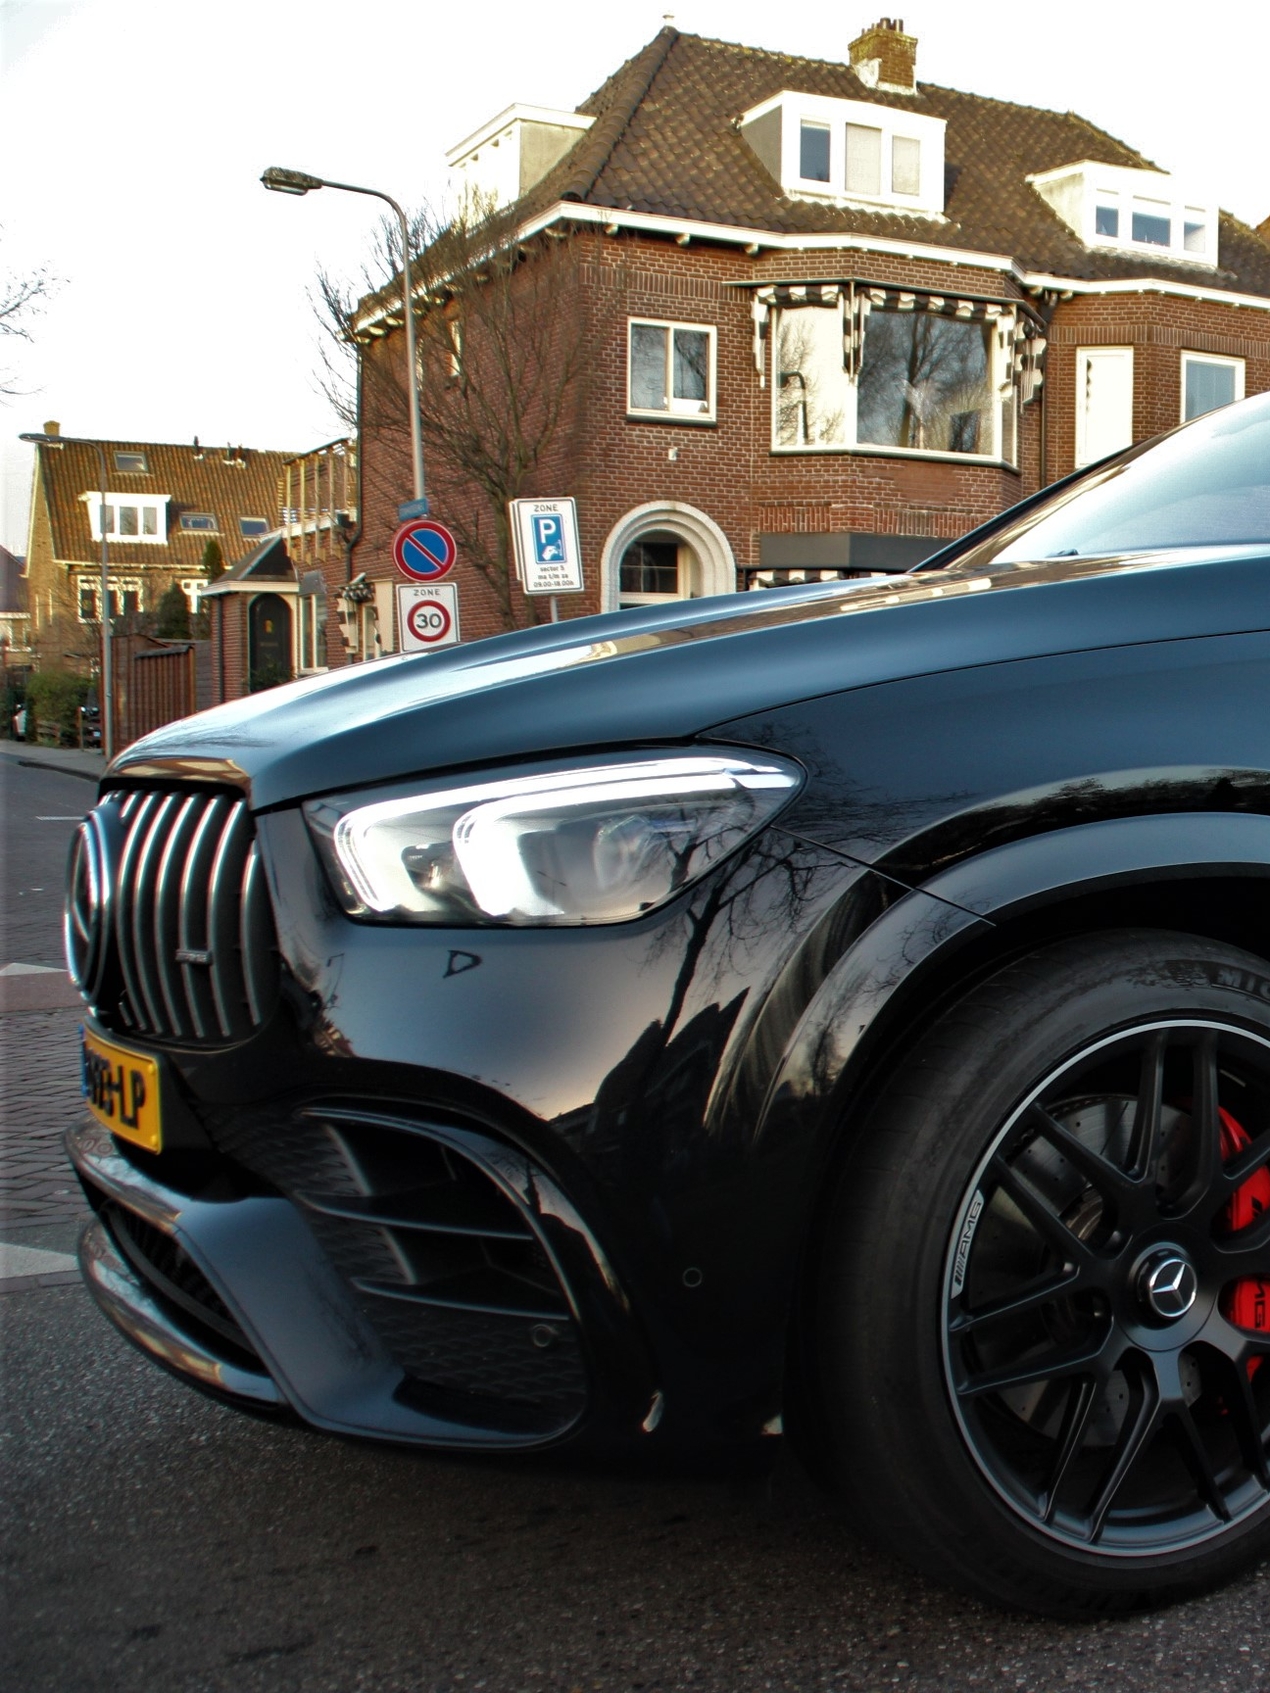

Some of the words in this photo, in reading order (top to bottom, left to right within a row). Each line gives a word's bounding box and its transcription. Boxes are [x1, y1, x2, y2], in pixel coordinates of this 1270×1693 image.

[533, 504, 559, 512] ZONE
[538, 519, 556, 544] P
[413, 588, 441, 596] ZONE
[416, 613, 442, 629] 30
